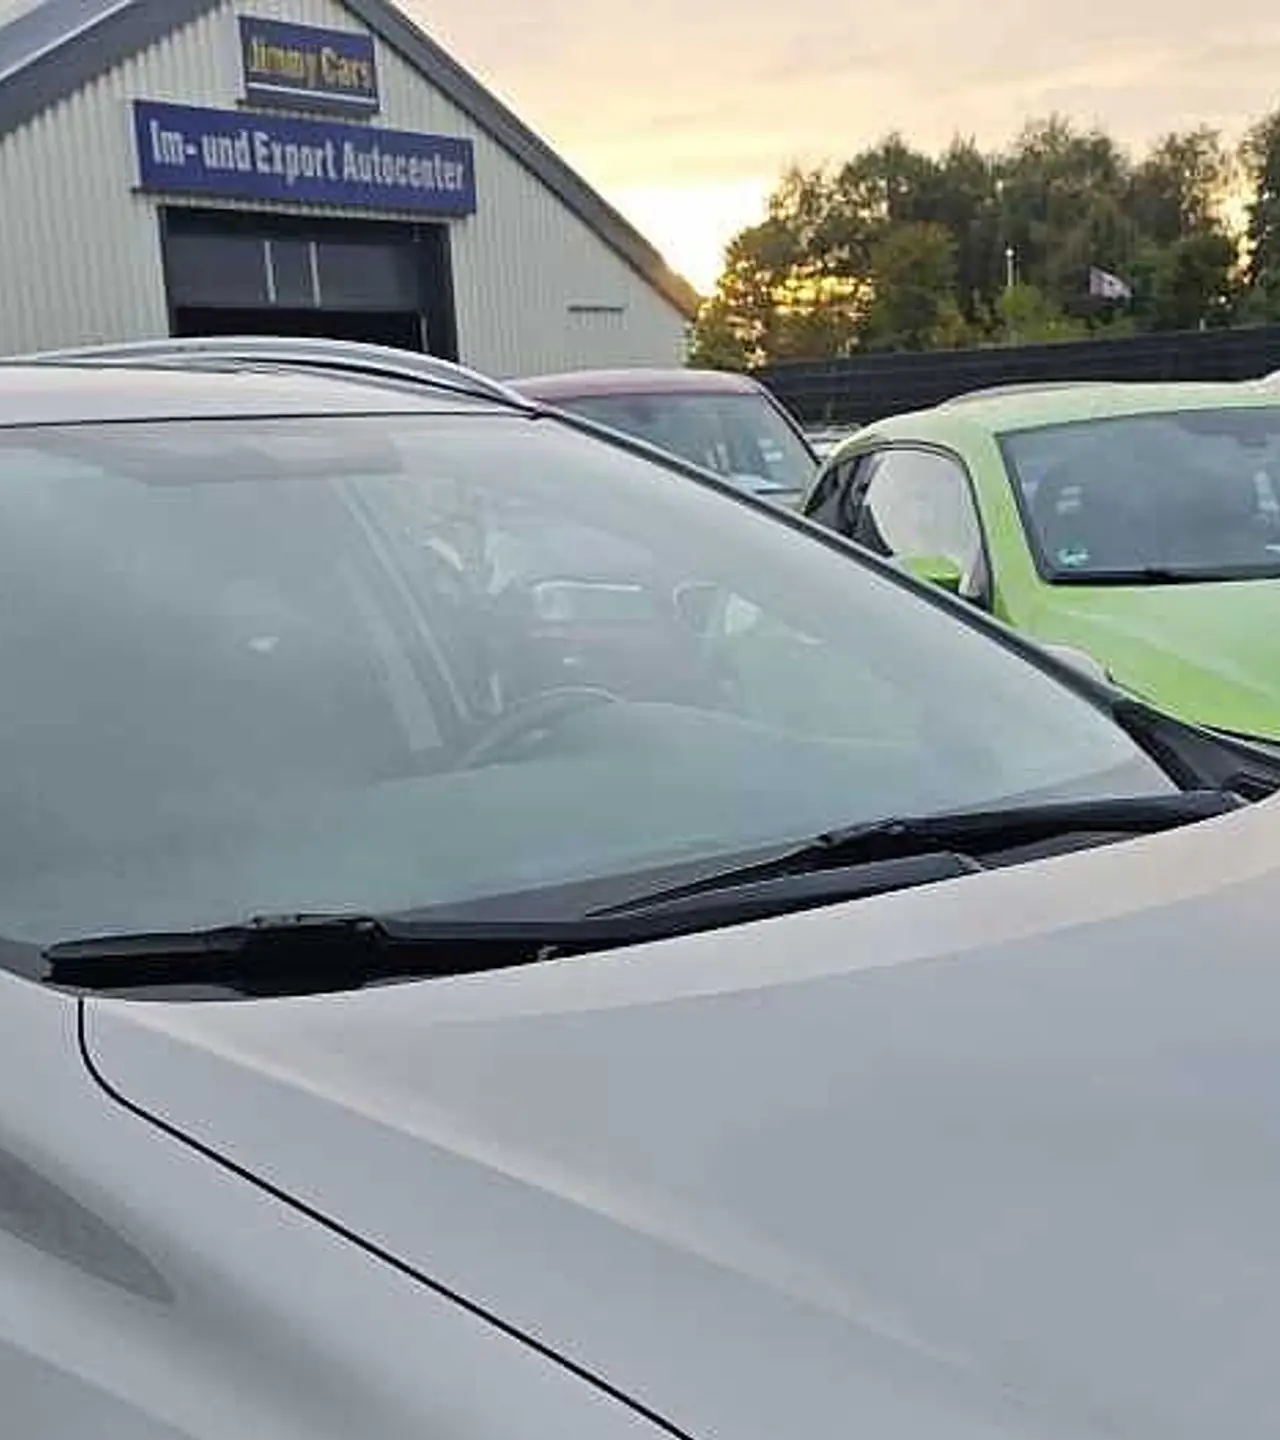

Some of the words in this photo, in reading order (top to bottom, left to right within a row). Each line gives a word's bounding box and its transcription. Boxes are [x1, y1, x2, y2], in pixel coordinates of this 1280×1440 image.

[149, 118, 196, 166] Im-
[201, 131, 251, 171] und
[254, 131, 337, 185] Export
[343, 141, 464, 191] Autocenter
